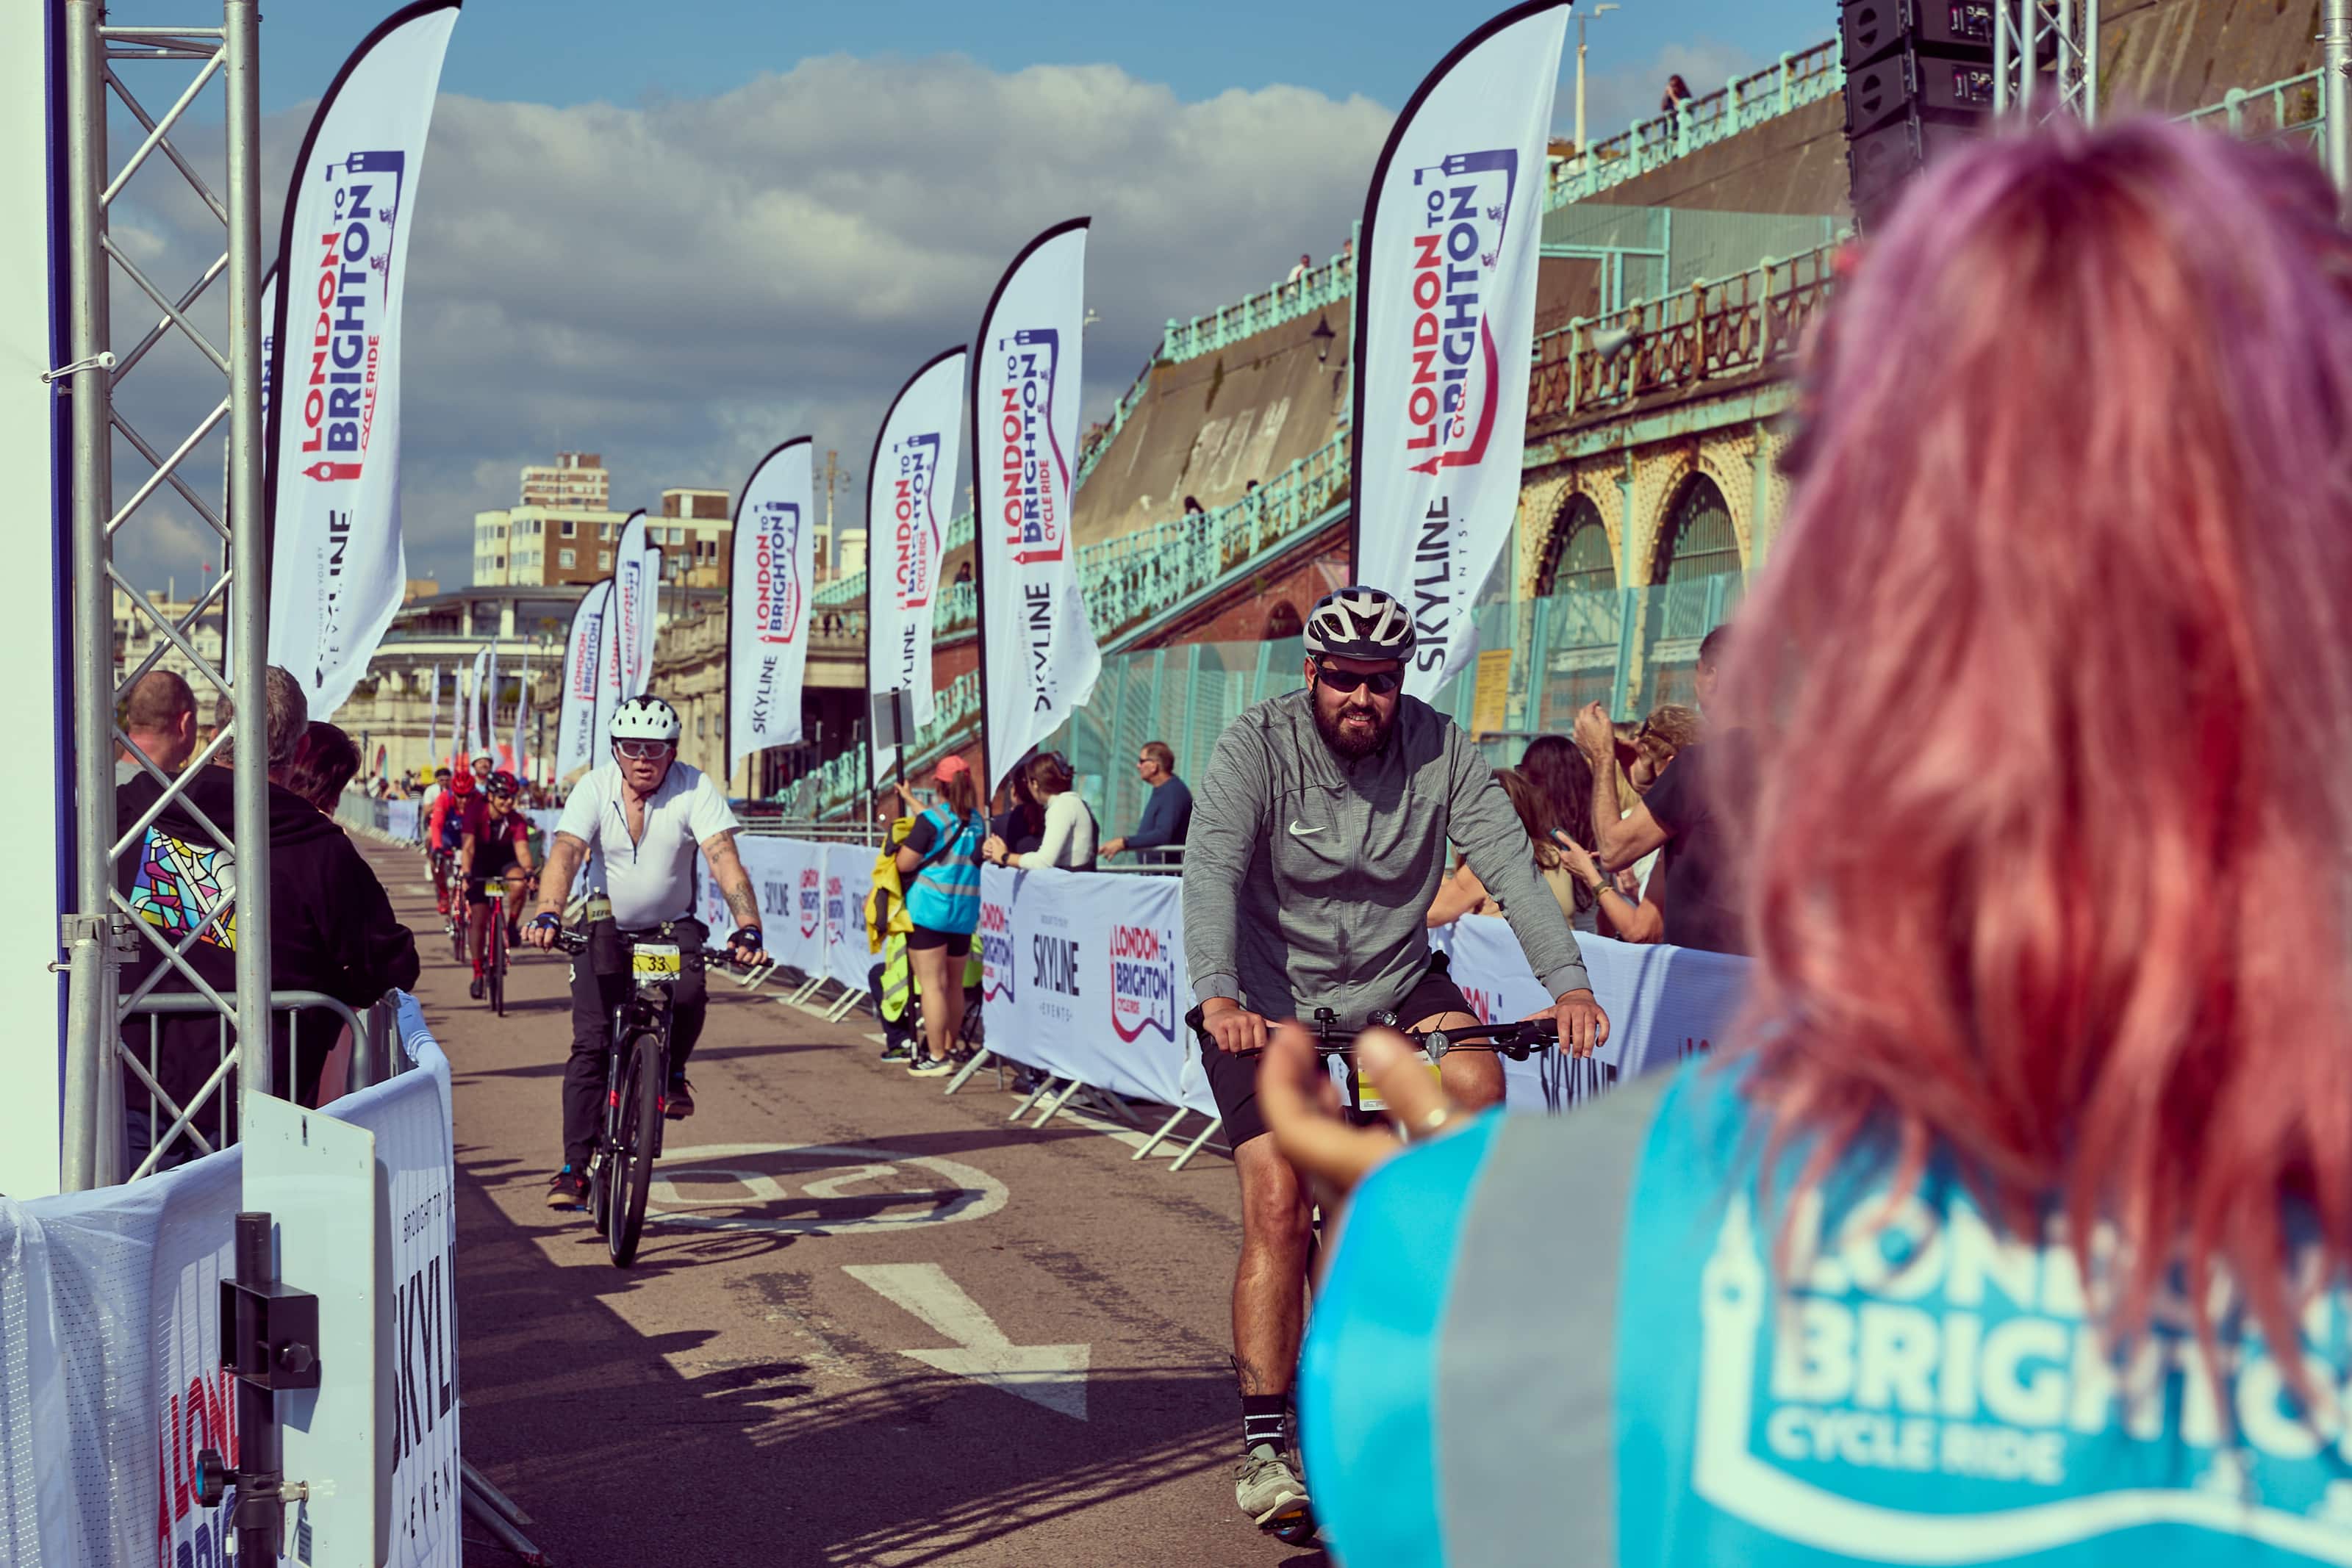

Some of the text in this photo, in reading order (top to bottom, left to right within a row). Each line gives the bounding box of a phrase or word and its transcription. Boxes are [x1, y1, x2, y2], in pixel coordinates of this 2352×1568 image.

[302, 187, 345, 453] LONDON TO
[327, 184, 373, 452] BRIGHTON
[366, 334, 379, 382] RIDE
[1407, 190, 1445, 450] LONDON TO
[901, 455, 910, 477] TO
[1001, 356, 1022, 544] LONDON TO
[1020, 353, 1042, 543] BRIGHTON
[1039, 459, 1055, 541] CYCLE RIDE
[757, 516, 770, 630] LONDON TO
[770, 516, 786, 631] BRIGHTON
[1415, 496, 1450, 672] SKYLINE
[1455, 530, 1469, 619] VENTS
[753, 655, 778, 735] SKYLINE
[903, 623, 916, 690] YLINE
[648, 956, 667, 972] 33
[1033, 933, 1080, 996] SKYLINE
[1114, 924, 1167, 963] LONDON TO
[1116, 961, 1169, 1001] BRIGHTON
[1771, 1299, 2352, 1466] BRIGHTO
[1768, 1404, 2065, 1486] CYCLE RIDE
